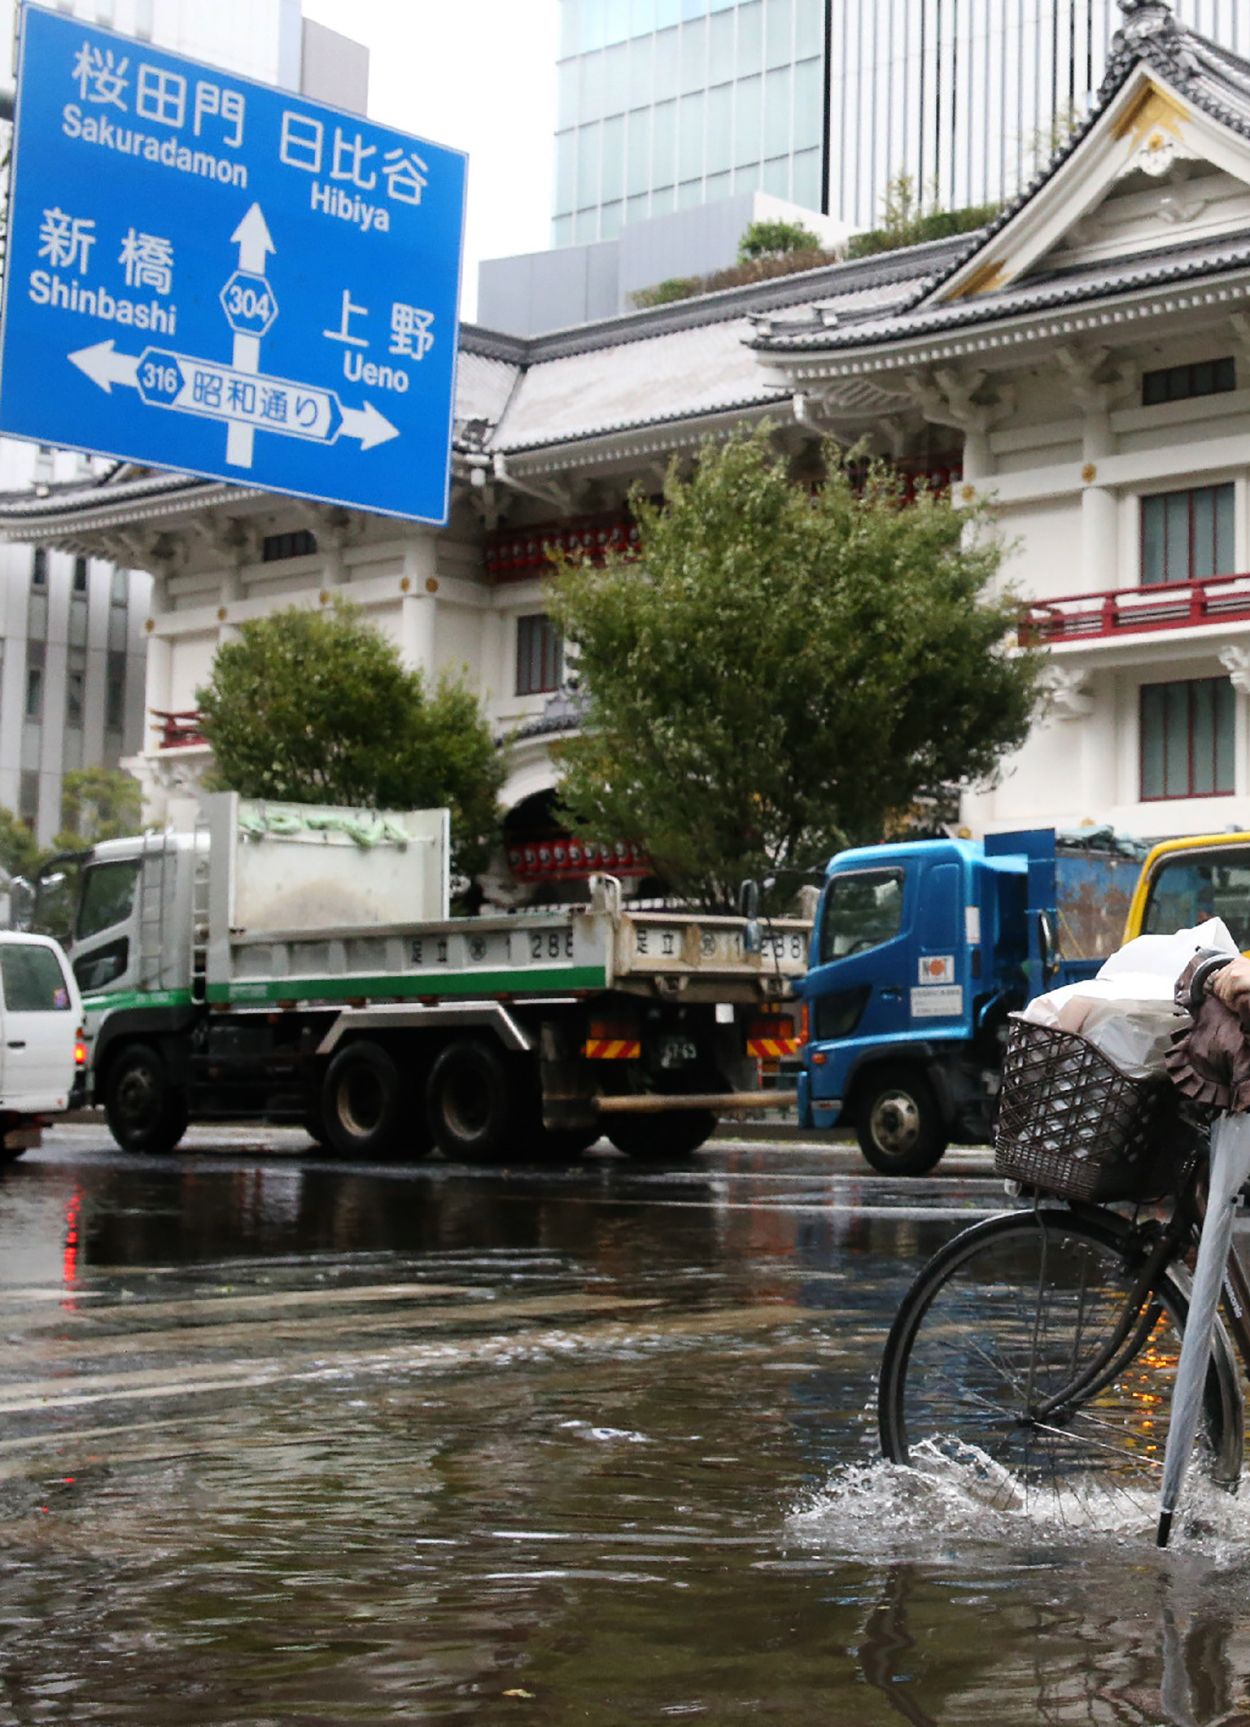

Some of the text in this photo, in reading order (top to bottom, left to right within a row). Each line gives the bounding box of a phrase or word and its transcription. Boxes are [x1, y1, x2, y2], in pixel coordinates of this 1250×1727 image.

[71, 40, 246, 148] 桜田門
[61, 103, 247, 190] Sakuradamon
[279, 110, 429, 206] 日比谷
[310, 180, 390, 233] Hibiya
[37, 206, 175, 296] 新橋
[28, 269, 177, 337] Shinbashi
[228, 284, 272, 323] 304
[322, 288, 435, 361] 上野
[142, 362, 179, 394] 316
[192, 370, 319, 428] 昭和通り
[343, 349, 410, 393] Ueno
